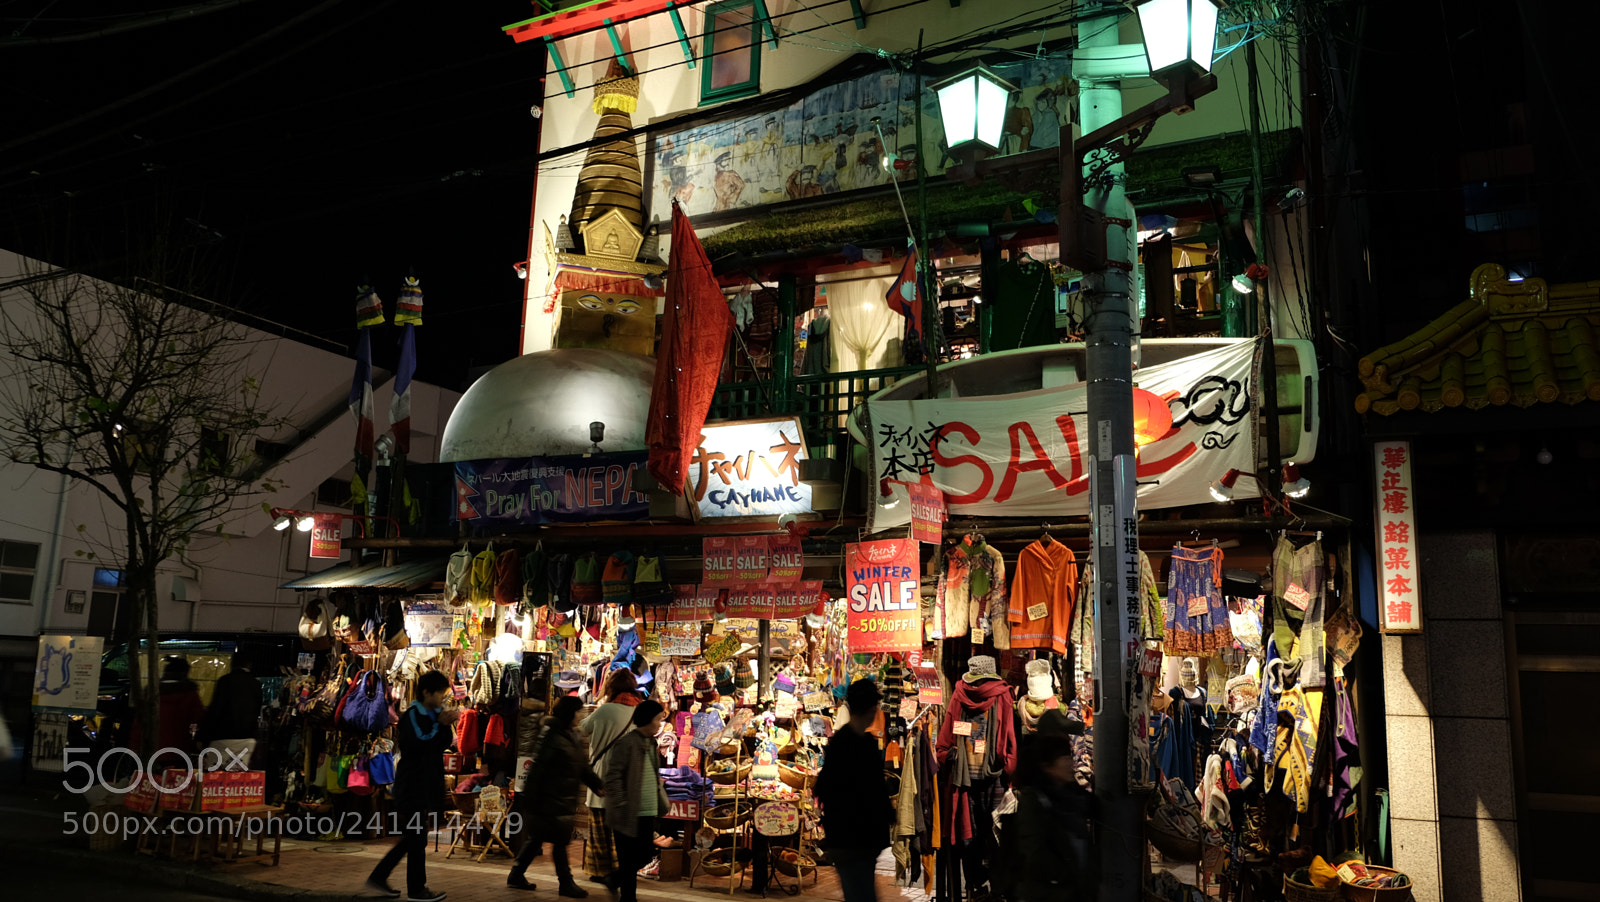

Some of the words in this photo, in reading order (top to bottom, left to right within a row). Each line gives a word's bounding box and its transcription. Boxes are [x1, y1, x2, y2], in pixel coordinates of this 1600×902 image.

[879, 421, 948, 449] チャイハネ
[690, 430, 801, 501] チャイハネ
[880, 447, 935, 480] 本店
[468, 466, 565, 484] ネパール大地震復興支援
[486, 490, 526, 519] Pray
[530, 485, 561, 511] For
[565, 461, 650, 510] NEPA
[925, 506, 942, 523] SALE
[314, 528, 340, 541] SALE
[704, 556, 734, 571] SALE
[736, 555, 766, 570] SALE
[772, 553, 803, 567] SALE
[853, 566, 912, 583] WINTER
[1124, 518, 1140, 634] 税理士事務所
[728, 595, 748, 607] SALE
[750, 596, 774, 607] SALE
[775, 596, 797, 607] SALE
[798, 594, 818, 606] SALE
[850, 580, 918, 612] SALE
[675, 599, 694, 609] SALE
[919, 678, 941, 689] SALE
[202, 786, 224, 797] SALE
[224, 786, 244, 797] SALE
[244, 786, 263, 796] SALE
[664, 802, 697, 818] ALE
